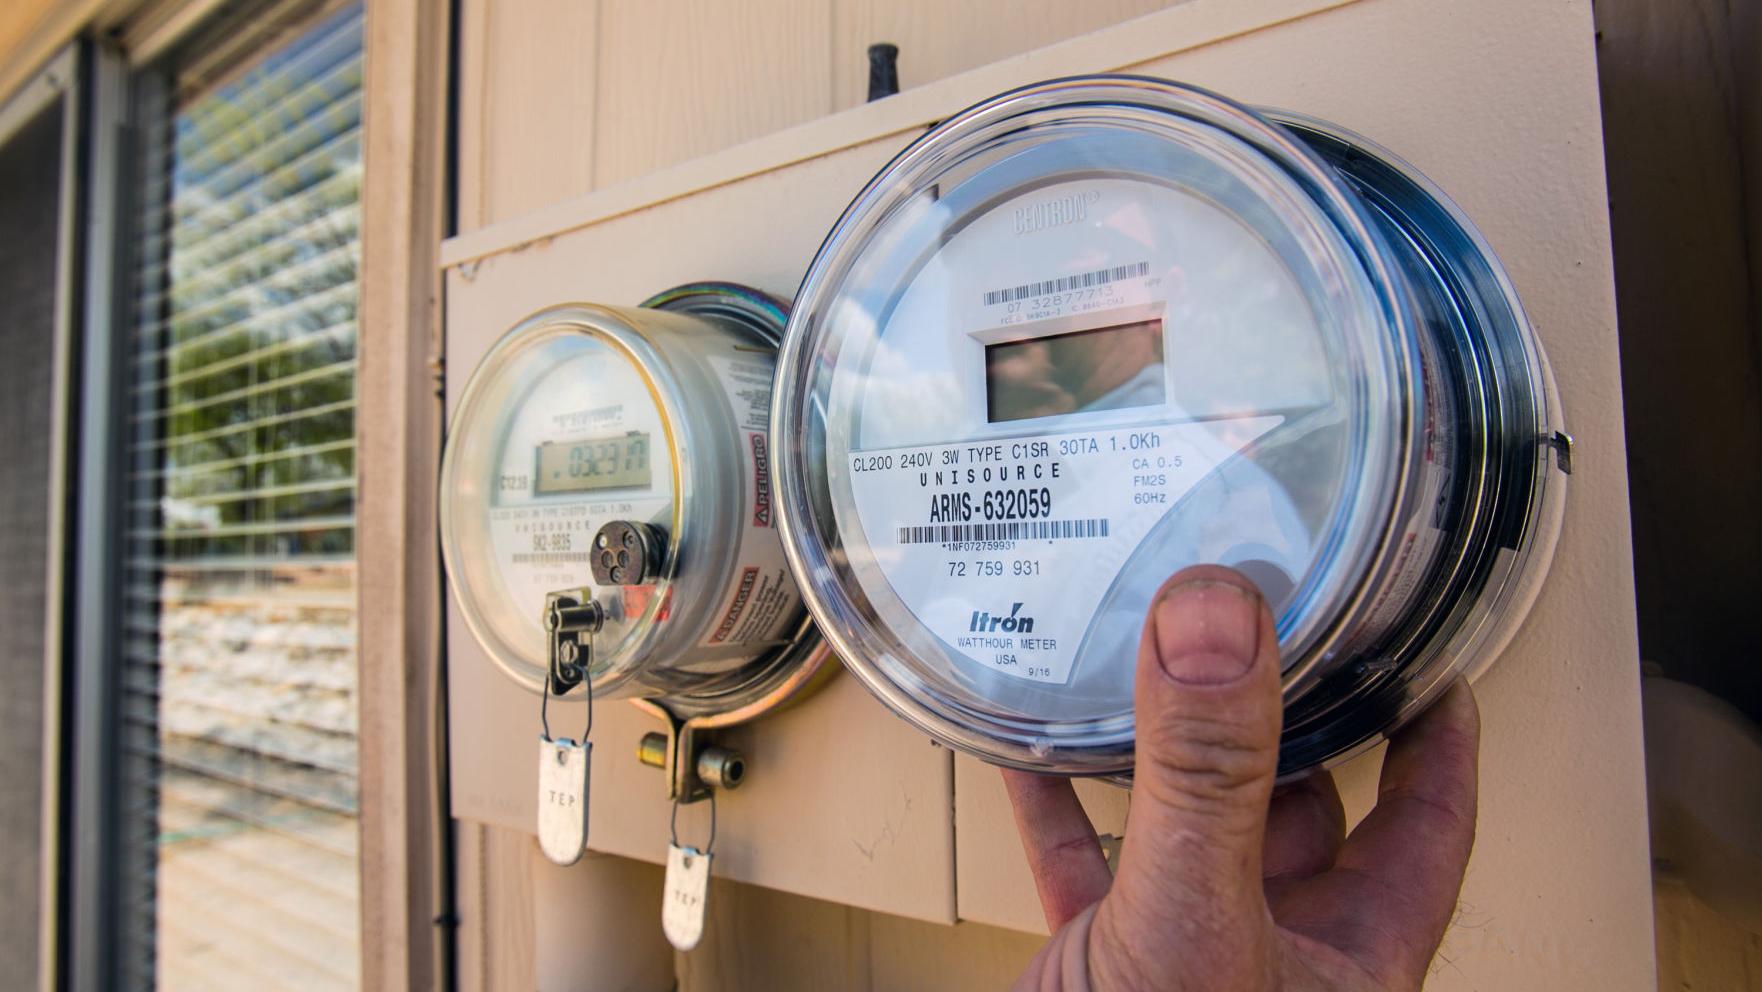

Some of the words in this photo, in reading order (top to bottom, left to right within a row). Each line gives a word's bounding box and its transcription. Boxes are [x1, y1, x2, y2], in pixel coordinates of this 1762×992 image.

[853, 455, 893, 472] CL200
[900, 452, 933, 469] 240V
[942, 449, 960, 465] 3W
[968, 446, 1002, 463] TYPE
[1012, 442, 1049, 459] C1SR
[1059, 438, 1099, 456] 30TA
[1110, 432, 1160, 451] 1.0Kh
[752, 434, 768, 505] PELIGRO
[1132, 458, 1150, 470] CA
[1157, 456, 1183, 468] 0.5
[920, 463, 1060, 486] UNISOURCE
[1134, 475, 1166, 487] FM2S
[930, 487, 1051, 523] ARMS-632059
[1134, 493, 1166, 504] 60Hz
[948, 561, 966, 577] 72
[975, 560, 1004, 576] 759
[1013, 560, 1040, 576] 931
[957, 637, 1013, 649] WATTHOUR
[1020, 638, 1057, 650] METER
[995, 654, 1017, 665] USA
[1028, 667, 1051, 678] 9/16
[549, 790, 575, 806] TEP
